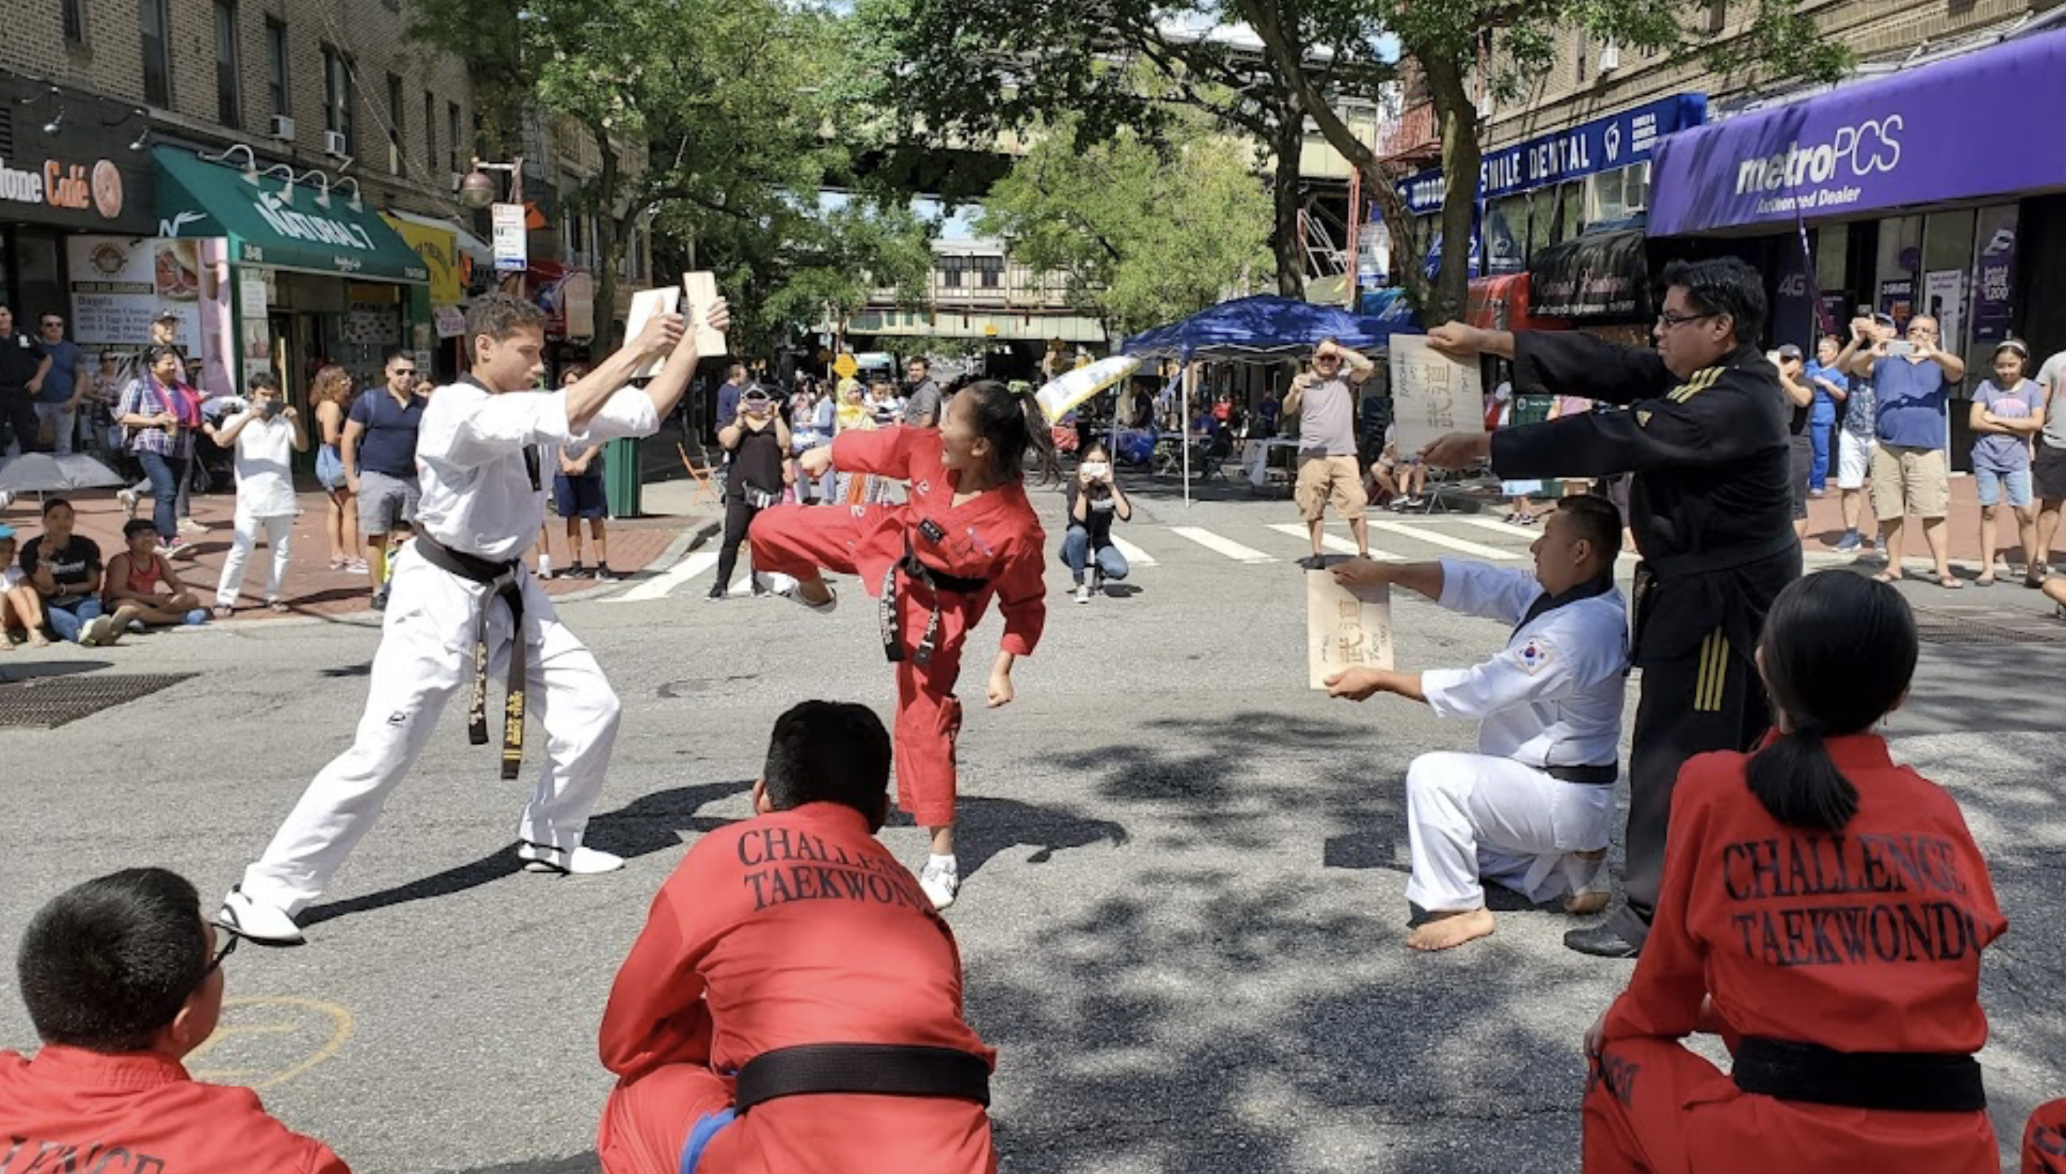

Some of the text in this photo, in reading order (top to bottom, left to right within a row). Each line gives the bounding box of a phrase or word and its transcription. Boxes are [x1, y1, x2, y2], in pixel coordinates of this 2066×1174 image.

[1480, 133, 1590, 192] SMILE DENTAL
[1736, 114, 1903, 194] metroPCS
[44, 159, 89, 209] Café
[1818, 185, 1861, 207] Dealer
[253, 197, 367, 249] NATURAL
[1777, 274, 1805, 297] 4G
[1722, 832, 1968, 900] CHALLENGE
